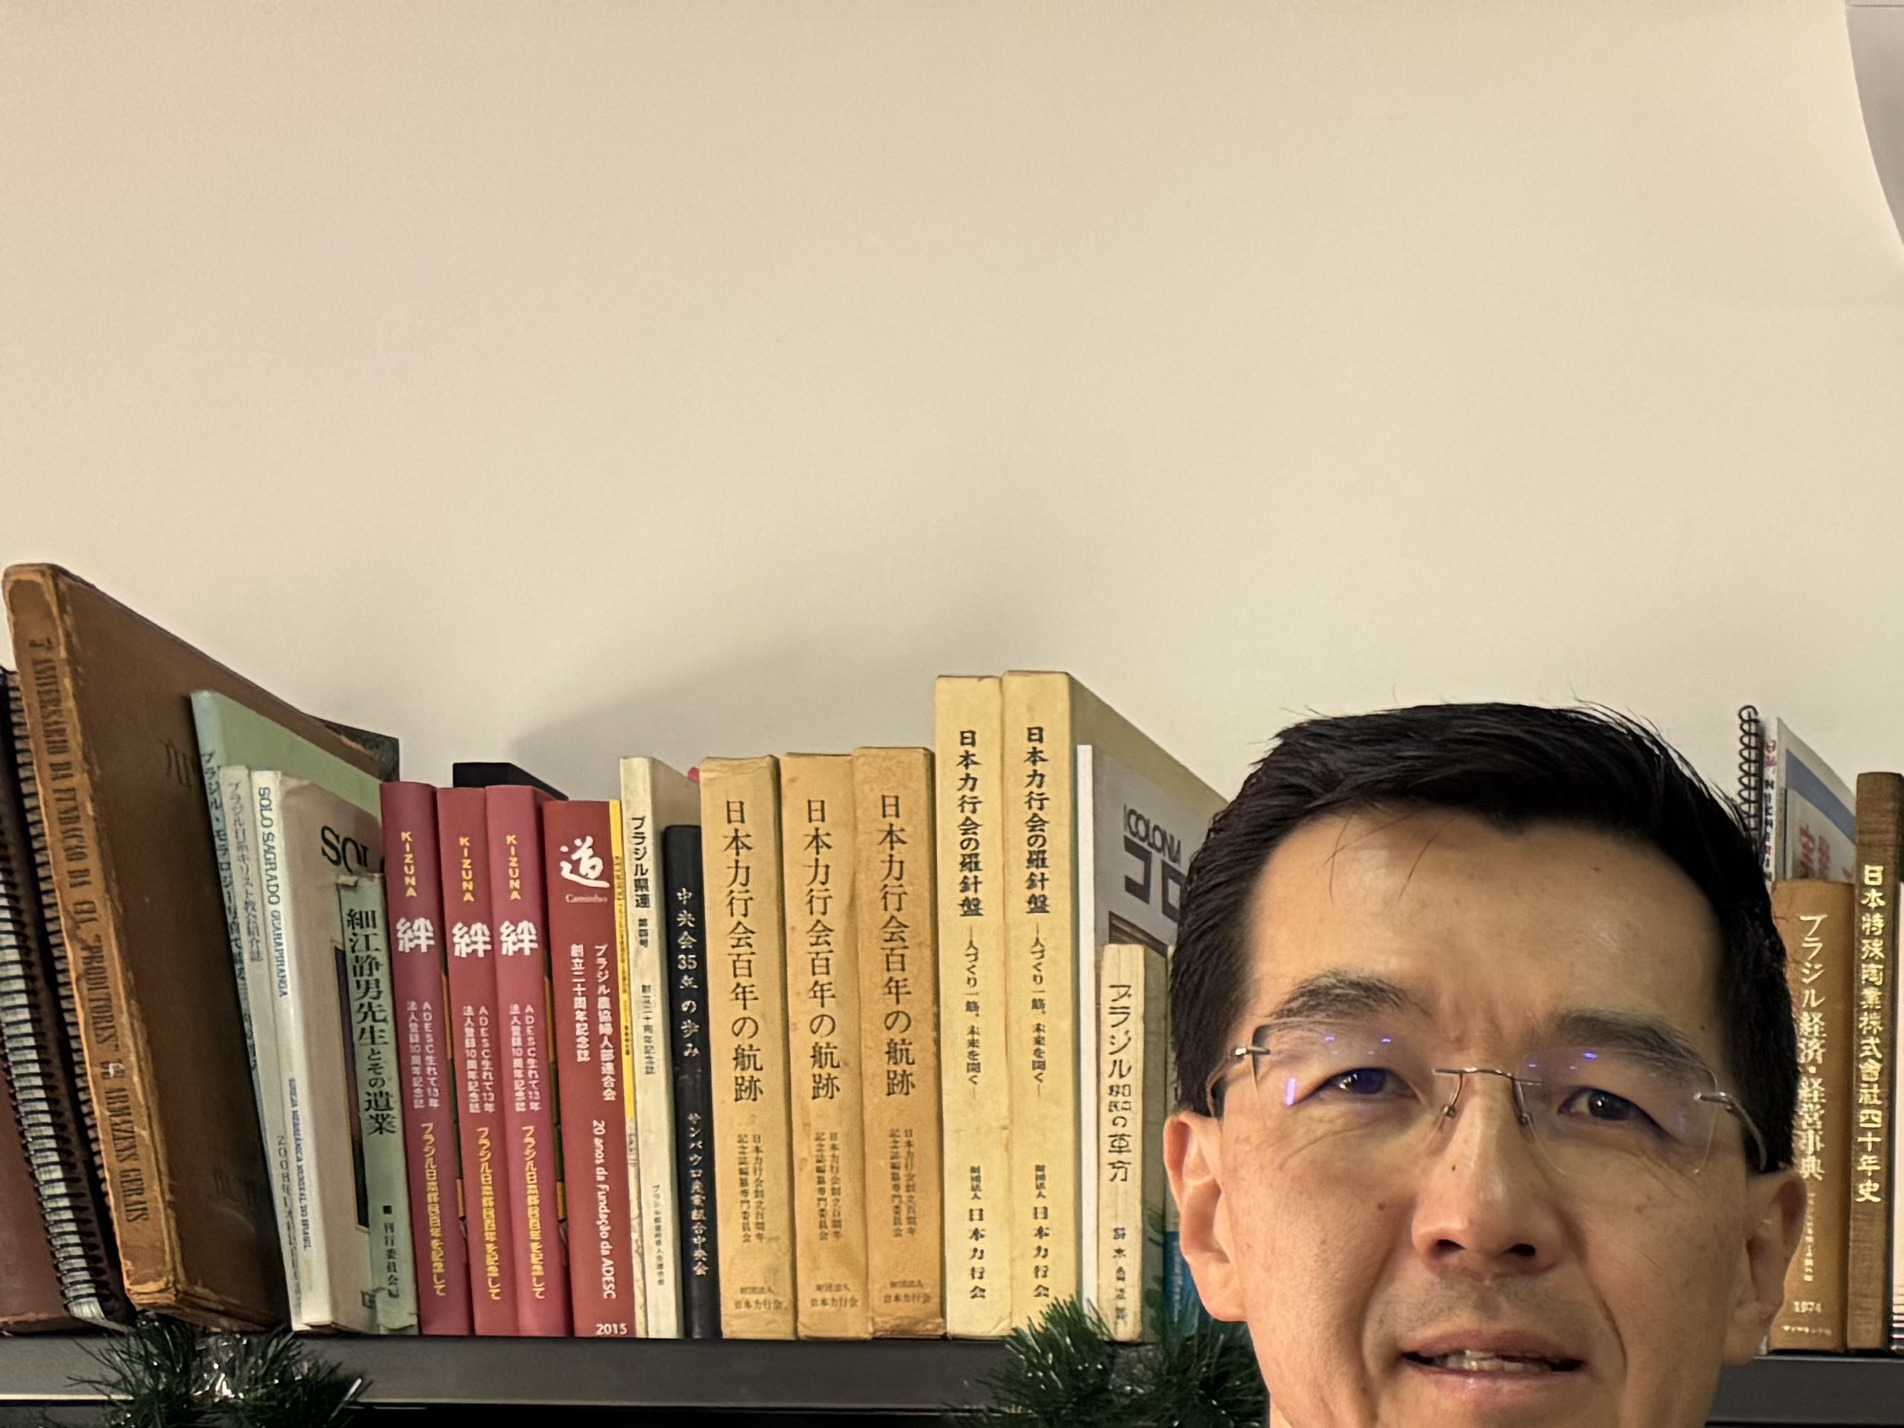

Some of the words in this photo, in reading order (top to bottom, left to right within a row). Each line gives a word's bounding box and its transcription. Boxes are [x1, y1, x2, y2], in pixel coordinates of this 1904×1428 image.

[259, 787, 274, 828] SOLO
[956, 729, 985, 918] 日本力行会の羅針盤
[1024, 726, 1051, 916] 日本力行会の羅針盤
[262, 831, 281, 905] SAGRADO
[402, 831, 418, 898] KIZUNA
[459, 837, 474, 902] KIZUNA
[506, 835, 521, 899] KIZUNA
[560, 836, 610, 888] 道
[397, 917, 435, 953] 絆
[452, 922, 493, 957] 絆
[499, 920, 539, 956] 絆
[724, 799, 764, 1102] 日本力行会百年の航跡
[804, 797, 841, 1100] 日本力行会百年の航跡
[879, 793, 917, 1098] 日本力行会百年の航跡
[347, 907, 398, 1136] 細江静男先生とその遺業
[1799, 914, 1828, 1182] ブラジル経済・経営事典
[1855, 865, 1885, 1203] 日本特殊陶業株式會社四十年史
[968, 1207, 986, 1299] 日本力行会
[1032, 1206, 1051, 1299] 日本力行会
[595, 1323, 628, 1336] 2015
